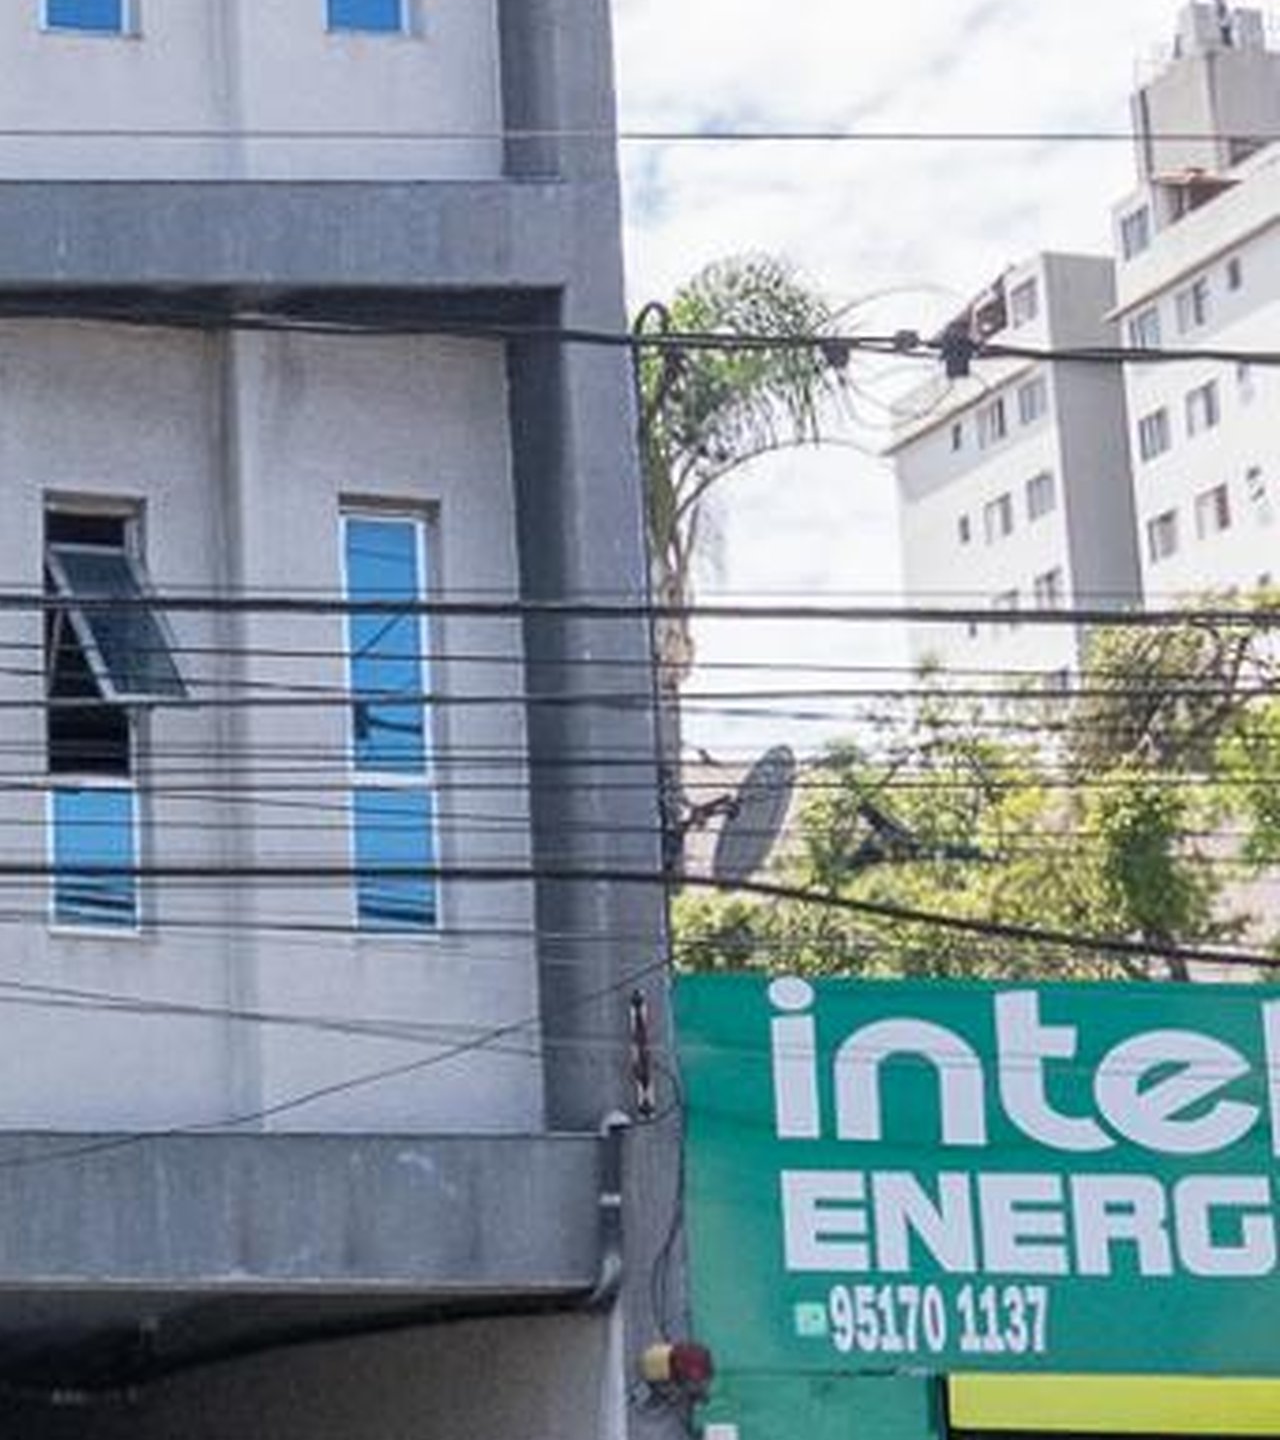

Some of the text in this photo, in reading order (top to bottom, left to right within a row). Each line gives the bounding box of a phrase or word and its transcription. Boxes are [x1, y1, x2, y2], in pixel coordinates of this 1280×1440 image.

[781, 1170, 1278, 1277] ENERG
[829, 1284, 1049, 1353] 95170 1137
